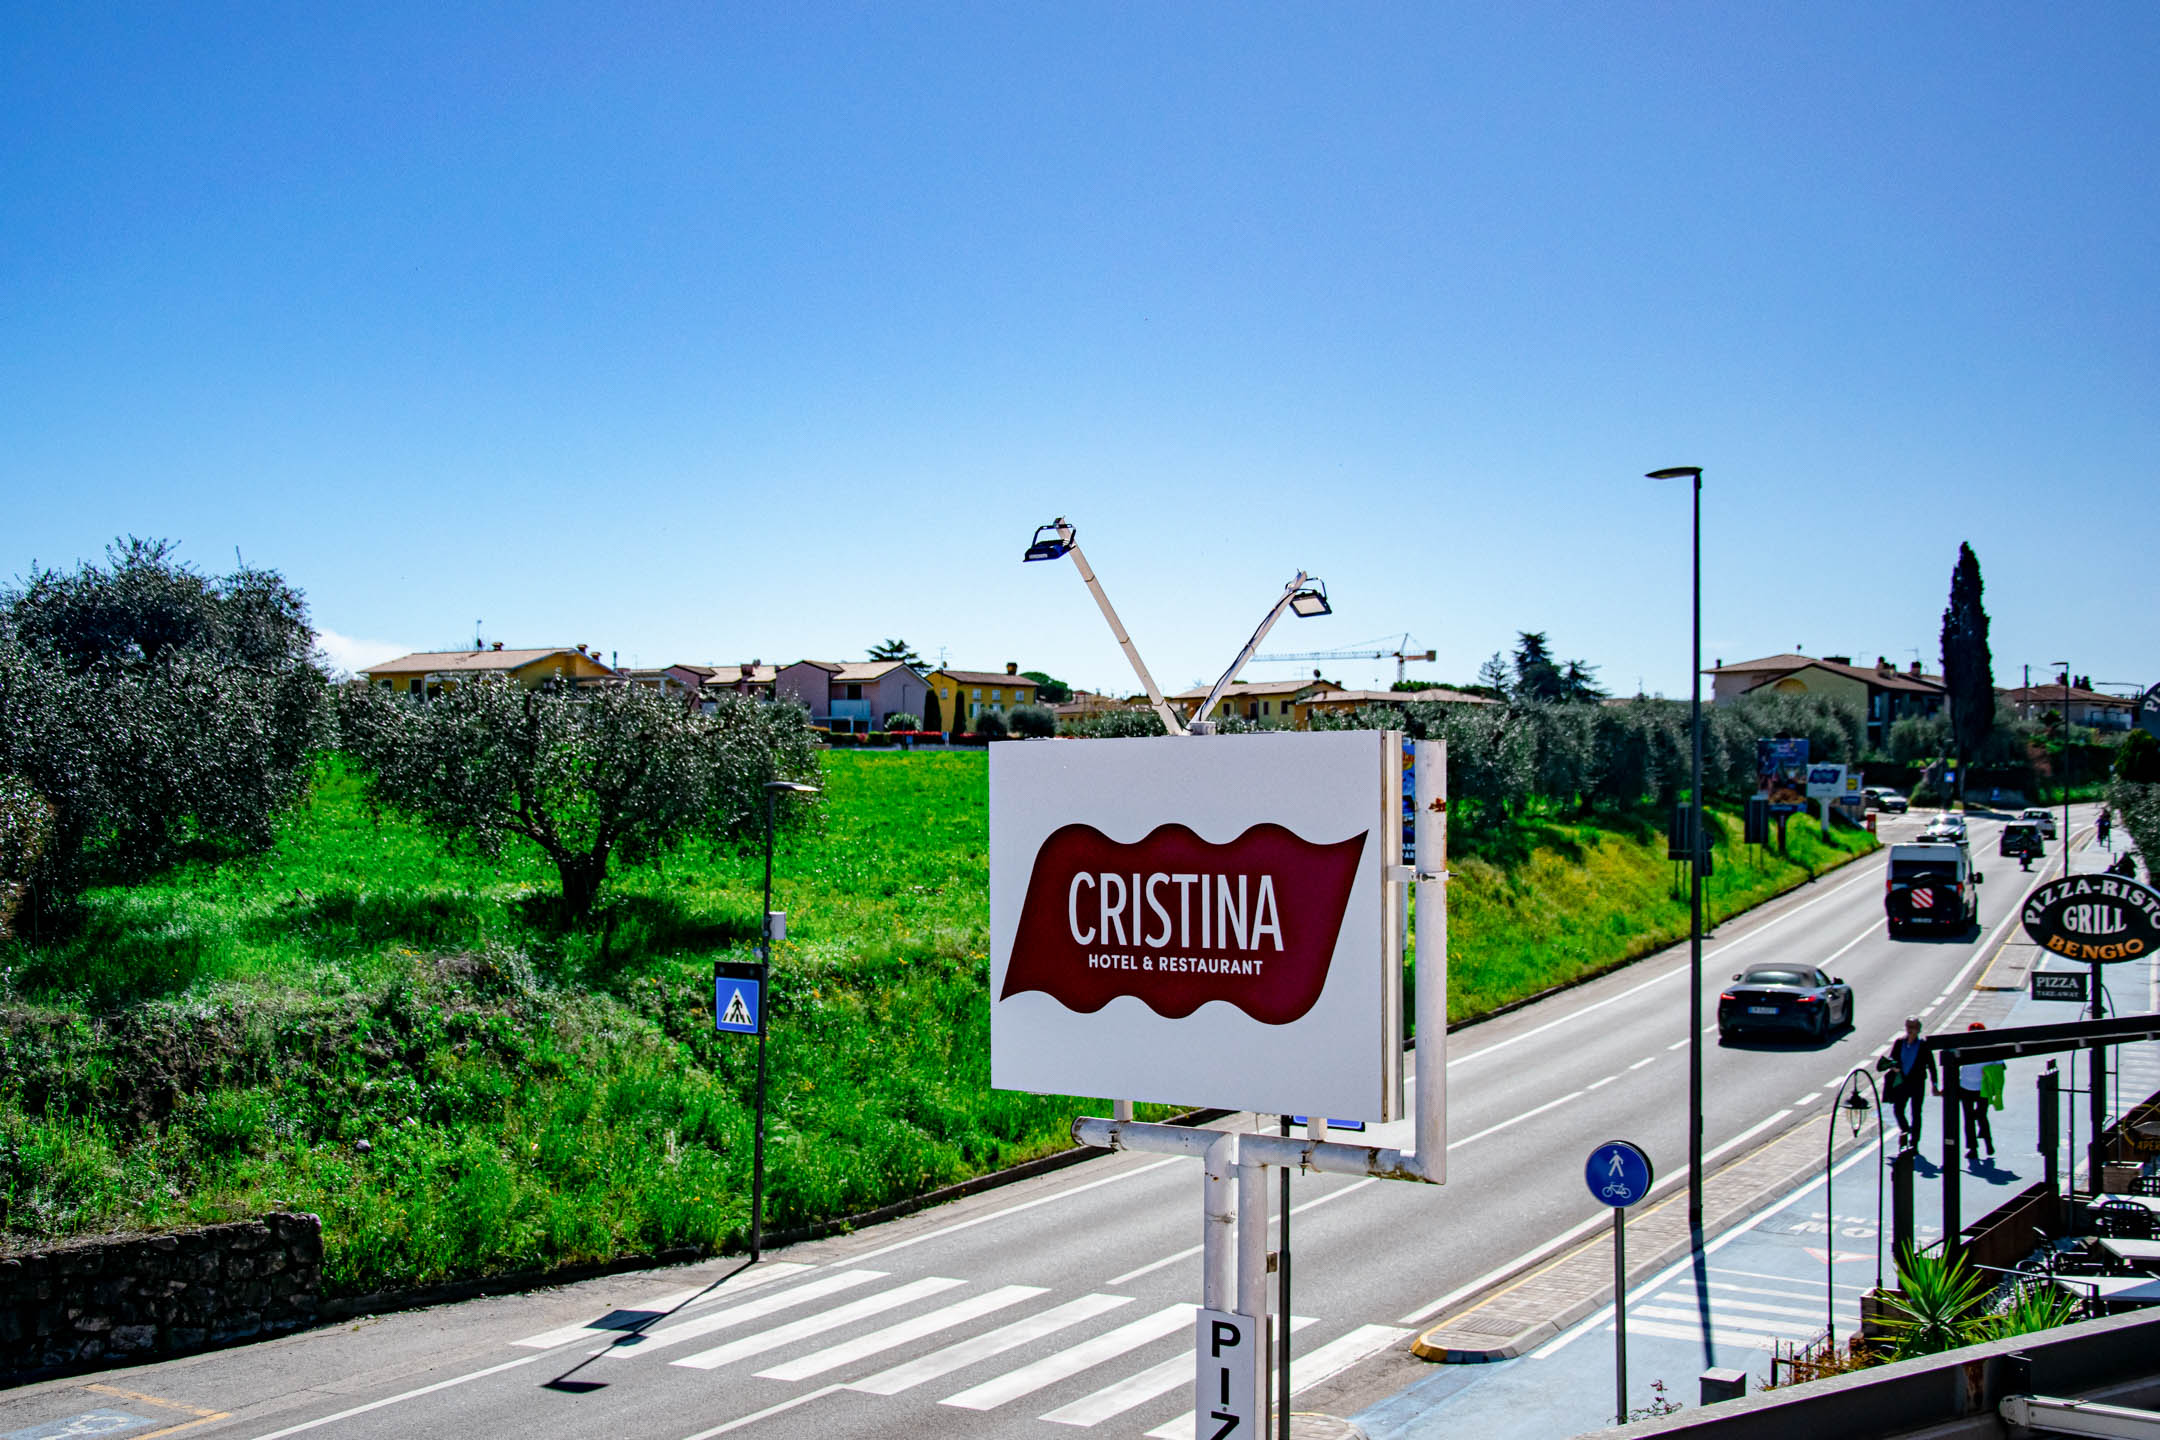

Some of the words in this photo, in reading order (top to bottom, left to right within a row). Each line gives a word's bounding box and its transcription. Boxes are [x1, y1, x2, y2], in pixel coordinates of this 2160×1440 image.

[1068, 871, 1284, 952] CRISTINA
[2062, 904, 2127, 934] GRILL
[2046, 934, 2144, 960] BENGIO
[1088, 953, 1138, 970] HOTEL
[1142, 955, 1153, 970] &
[1158, 956, 1263, 976] RESTAURANT
[2036, 976, 2079, 988] PIZZA
[1211, 1320, 1241, 1440] PIZ
